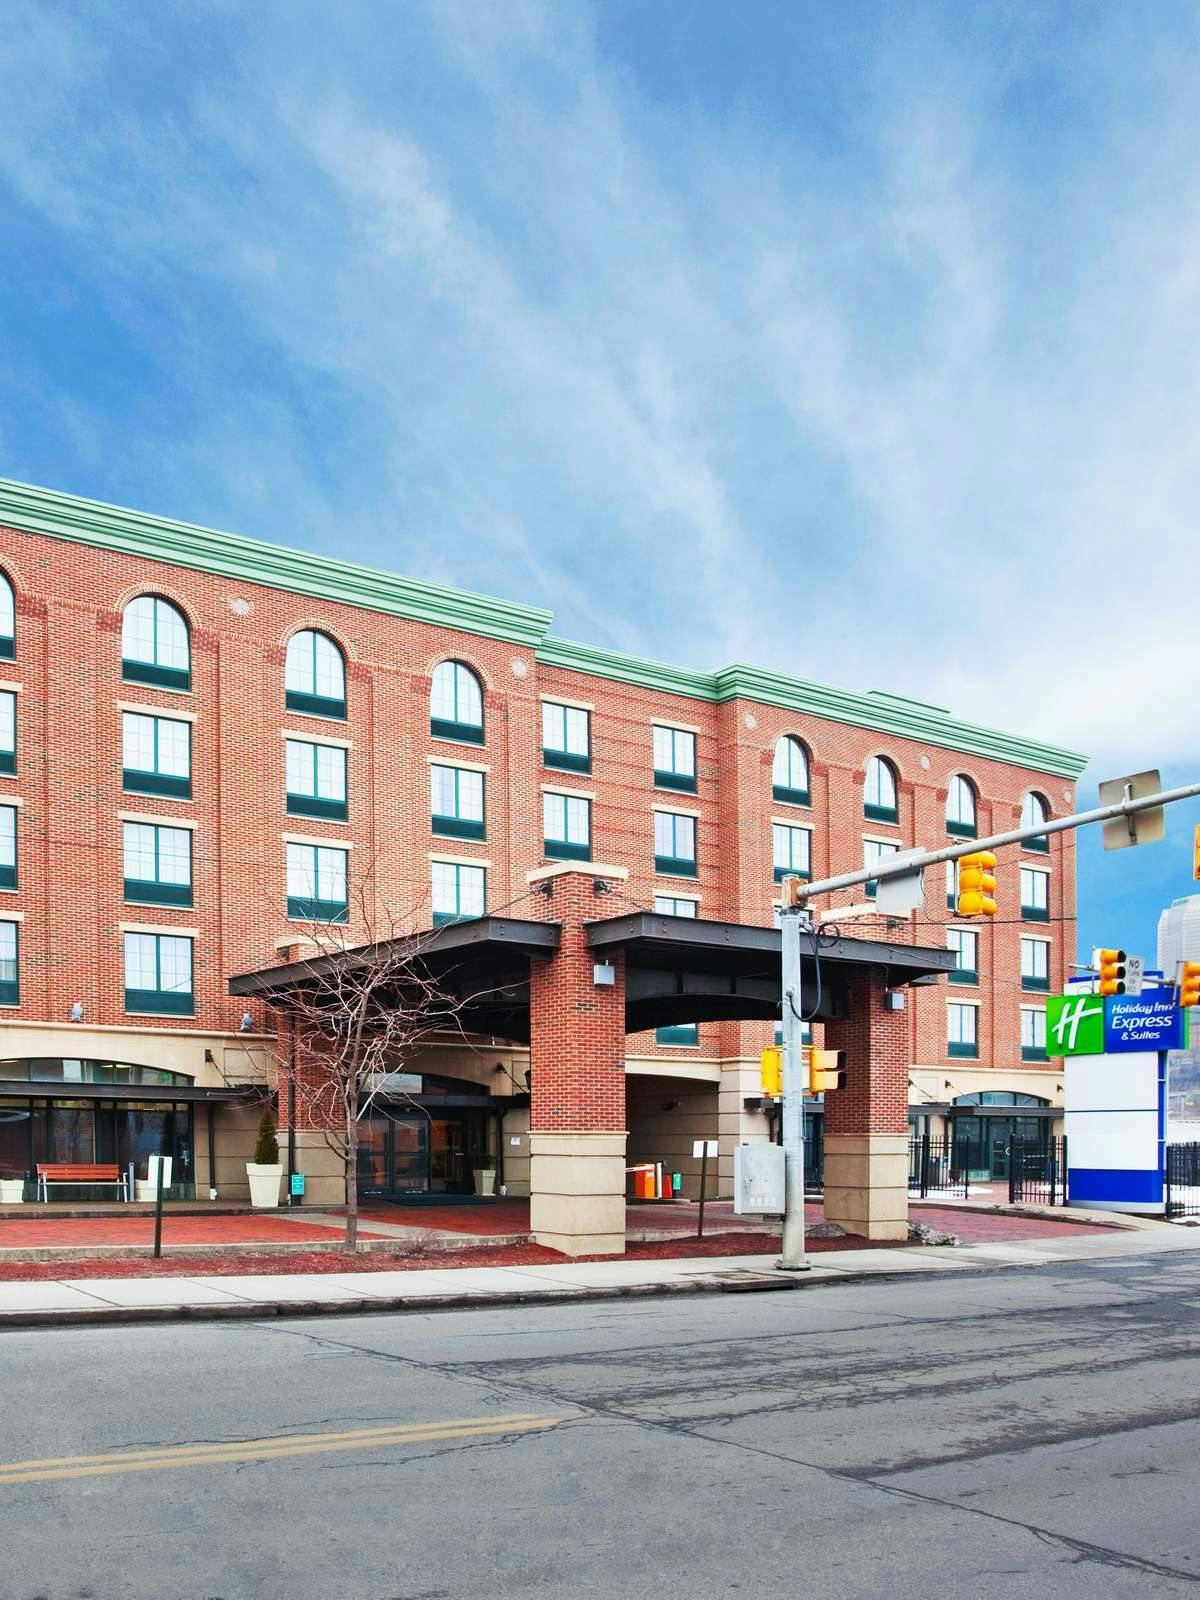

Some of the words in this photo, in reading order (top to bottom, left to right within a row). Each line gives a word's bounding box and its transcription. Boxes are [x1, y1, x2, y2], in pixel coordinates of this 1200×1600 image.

[1129, 959, 1140, 969] NO
[1112, 1003, 1154, 1015] Holiday
[1154, 1001, 1173, 1012] Inn
[1111, 1015, 1173, 1031] Express
[1121, 1031, 1129, 1041] &
[1130, 1030, 1161, 1040] Suites
